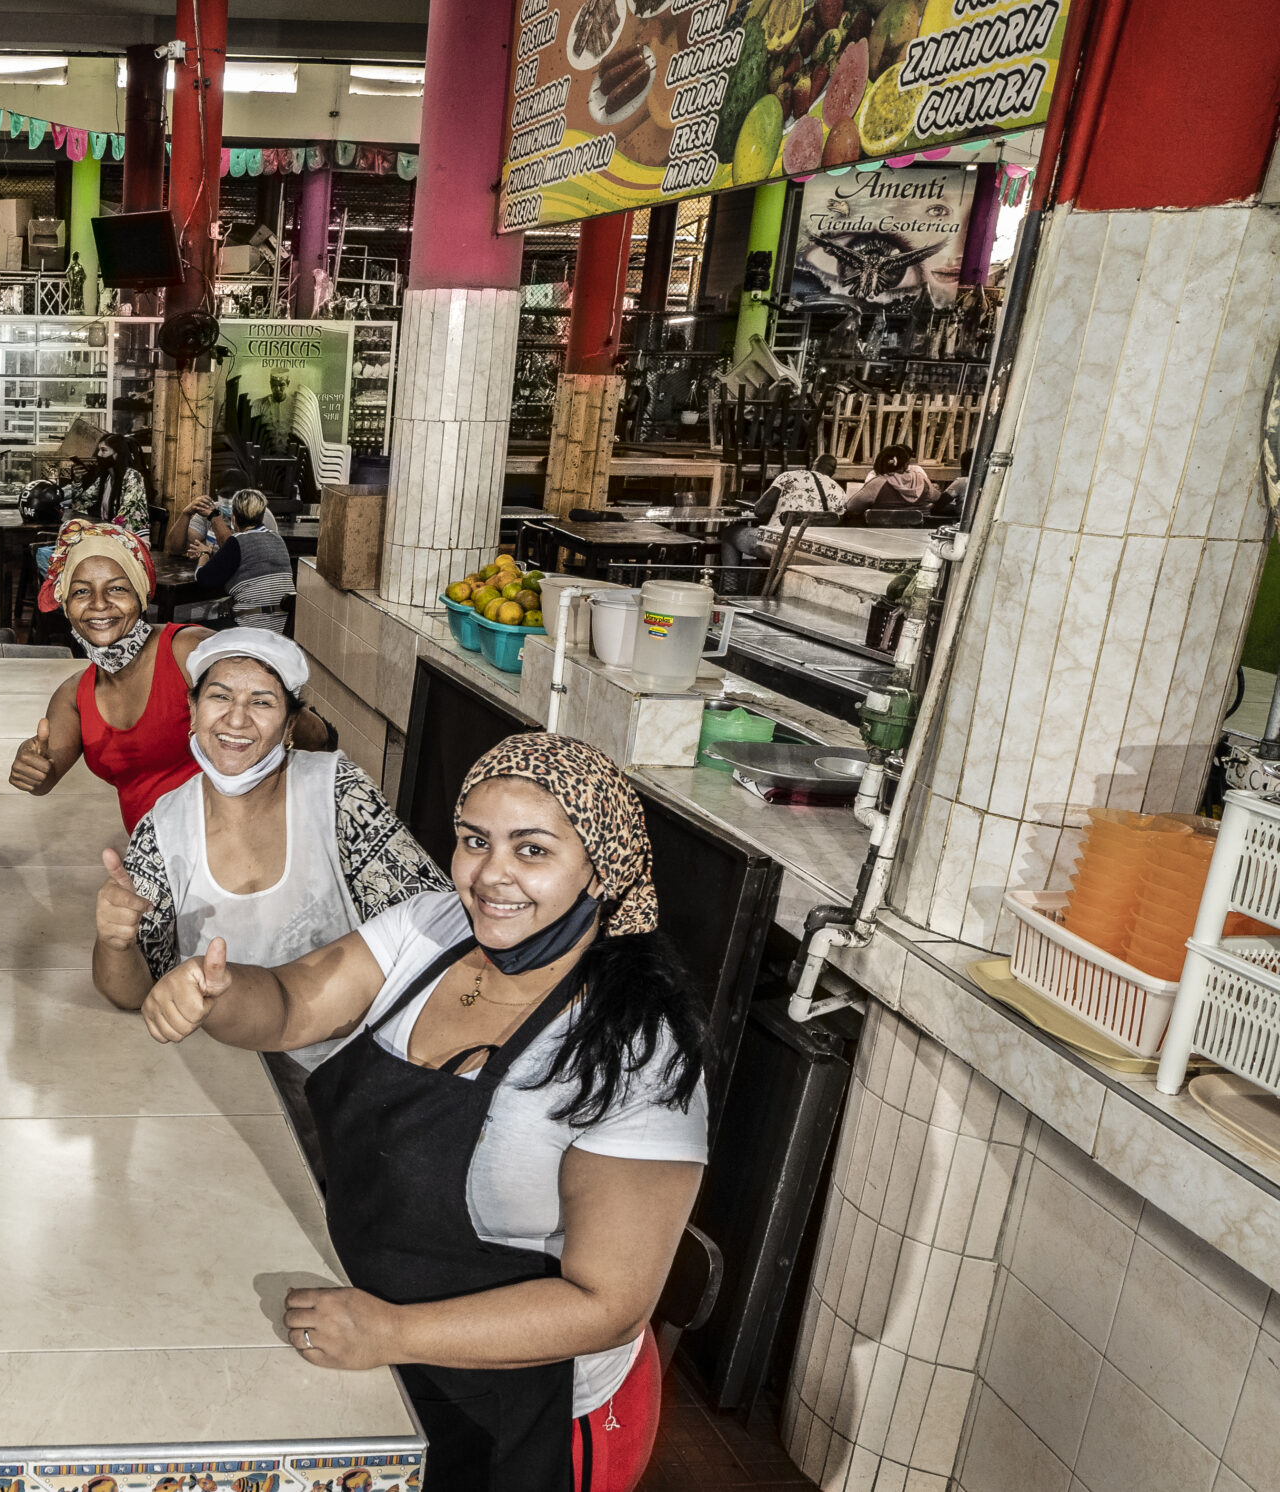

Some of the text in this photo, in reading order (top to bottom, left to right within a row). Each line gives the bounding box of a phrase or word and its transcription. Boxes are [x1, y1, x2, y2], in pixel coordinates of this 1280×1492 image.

[518, 10, 559, 59] COSTILLA
[899, 0, 1059, 89] ZANAHORIA
[515, 56, 538, 95] BOFE
[666, 28, 744, 88] LIMONADA
[512, 76, 571, 129] CHICHARRON
[671, 75, 728, 122] LULADA
[915, 60, 1048, 138] GUAYABA
[509, 114, 566, 162] CHUNCHULLO
[670, 114, 718, 157] FRESA
[507, 158, 545, 196] CHORIZO
[542, 149, 573, 185] MIXTO
[580, 132, 615, 173] POLLO
[662, 152, 718, 194] MANGO
[835, 171, 946, 200] Amenti
[504, 193, 542, 229] GASEOSA
[810, 214, 960, 233] Tienda Esoterica
[248, 324, 322, 337] PRODUCTOS
[248, 340, 321, 357] CARACAS
[262, 359, 306, 369] BOTANICA
